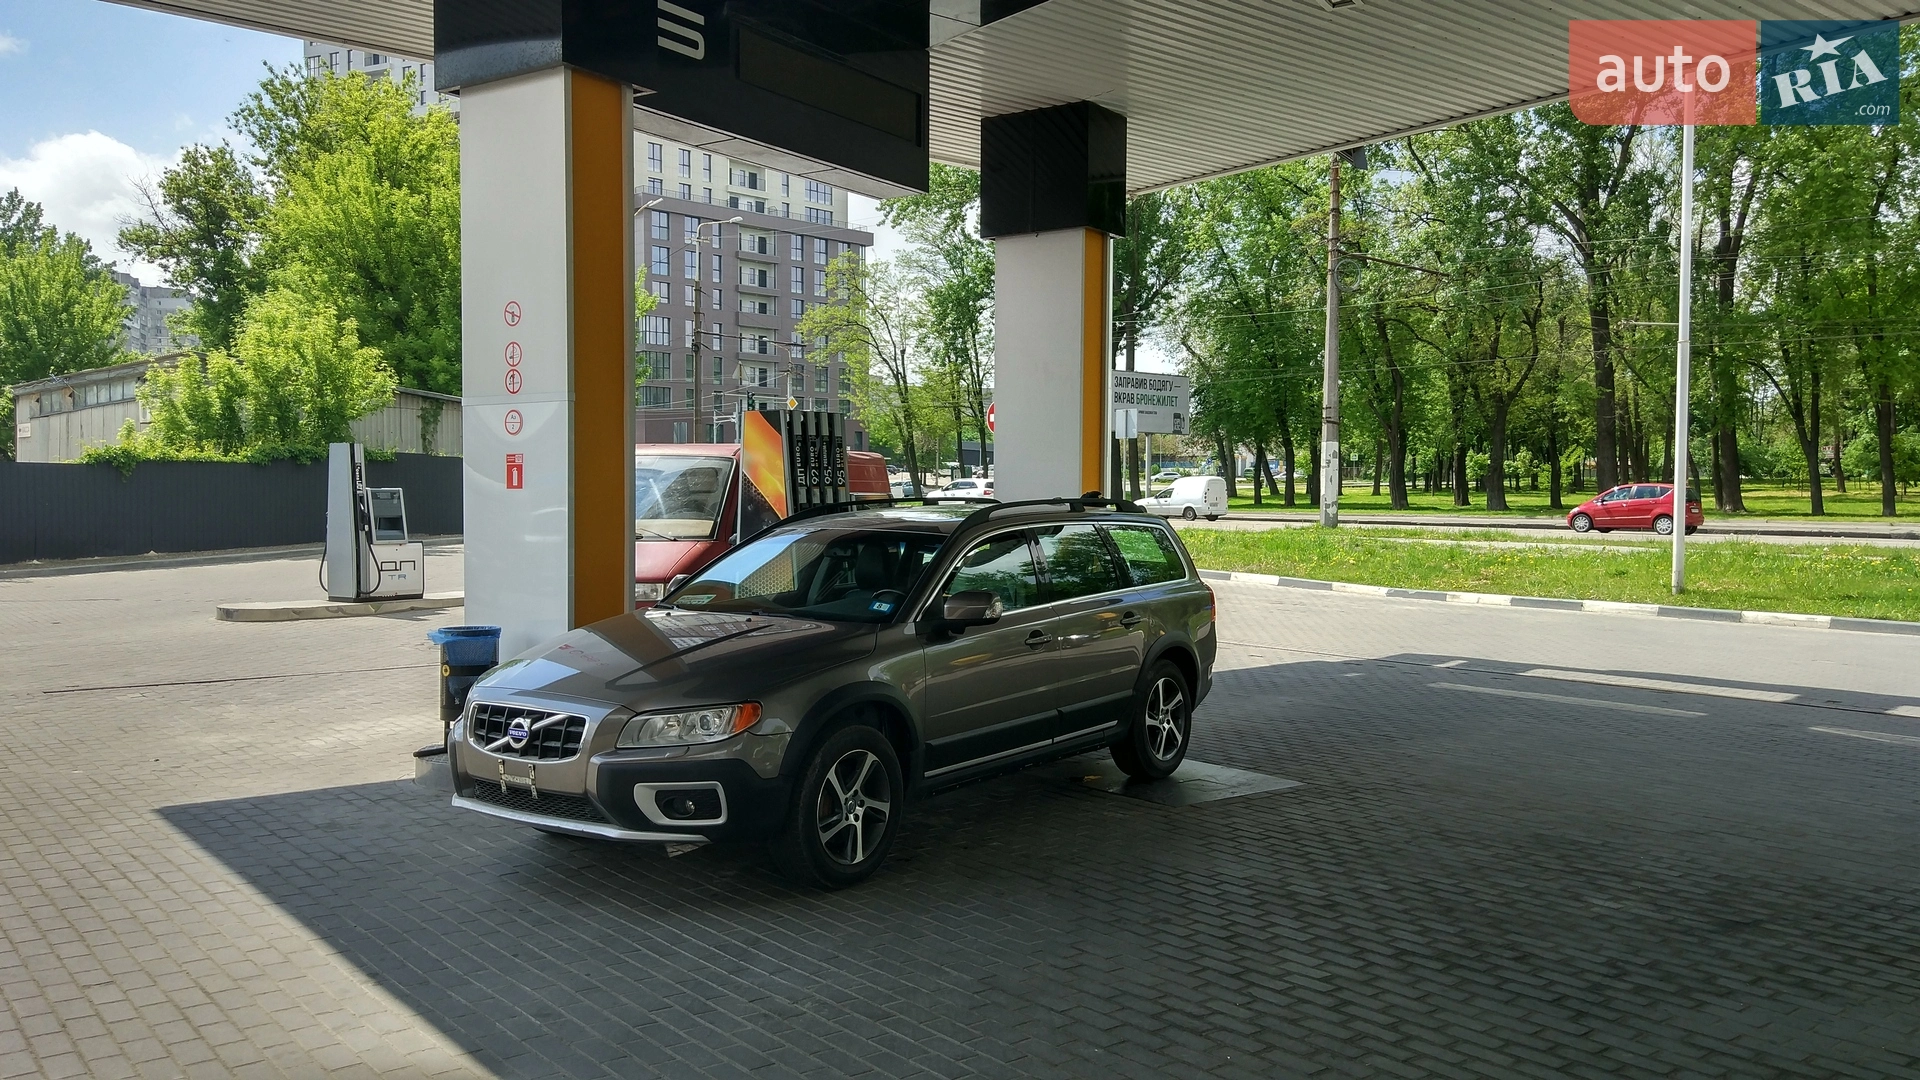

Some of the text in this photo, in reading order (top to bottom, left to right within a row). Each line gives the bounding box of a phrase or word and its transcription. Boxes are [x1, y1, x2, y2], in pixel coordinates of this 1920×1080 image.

[1114, 376, 1148, 390] ЗАПРАВИВ
[1149, 378, 1174, 392] БОДЯГУ
[1114, 391, 1178, 407] ВКРАВ БРОНЕЖИЛЕТ
[811, 469, 819, 485] 92
[837, 469, 846, 485] 95
[380, 560, 415, 571] ДП
